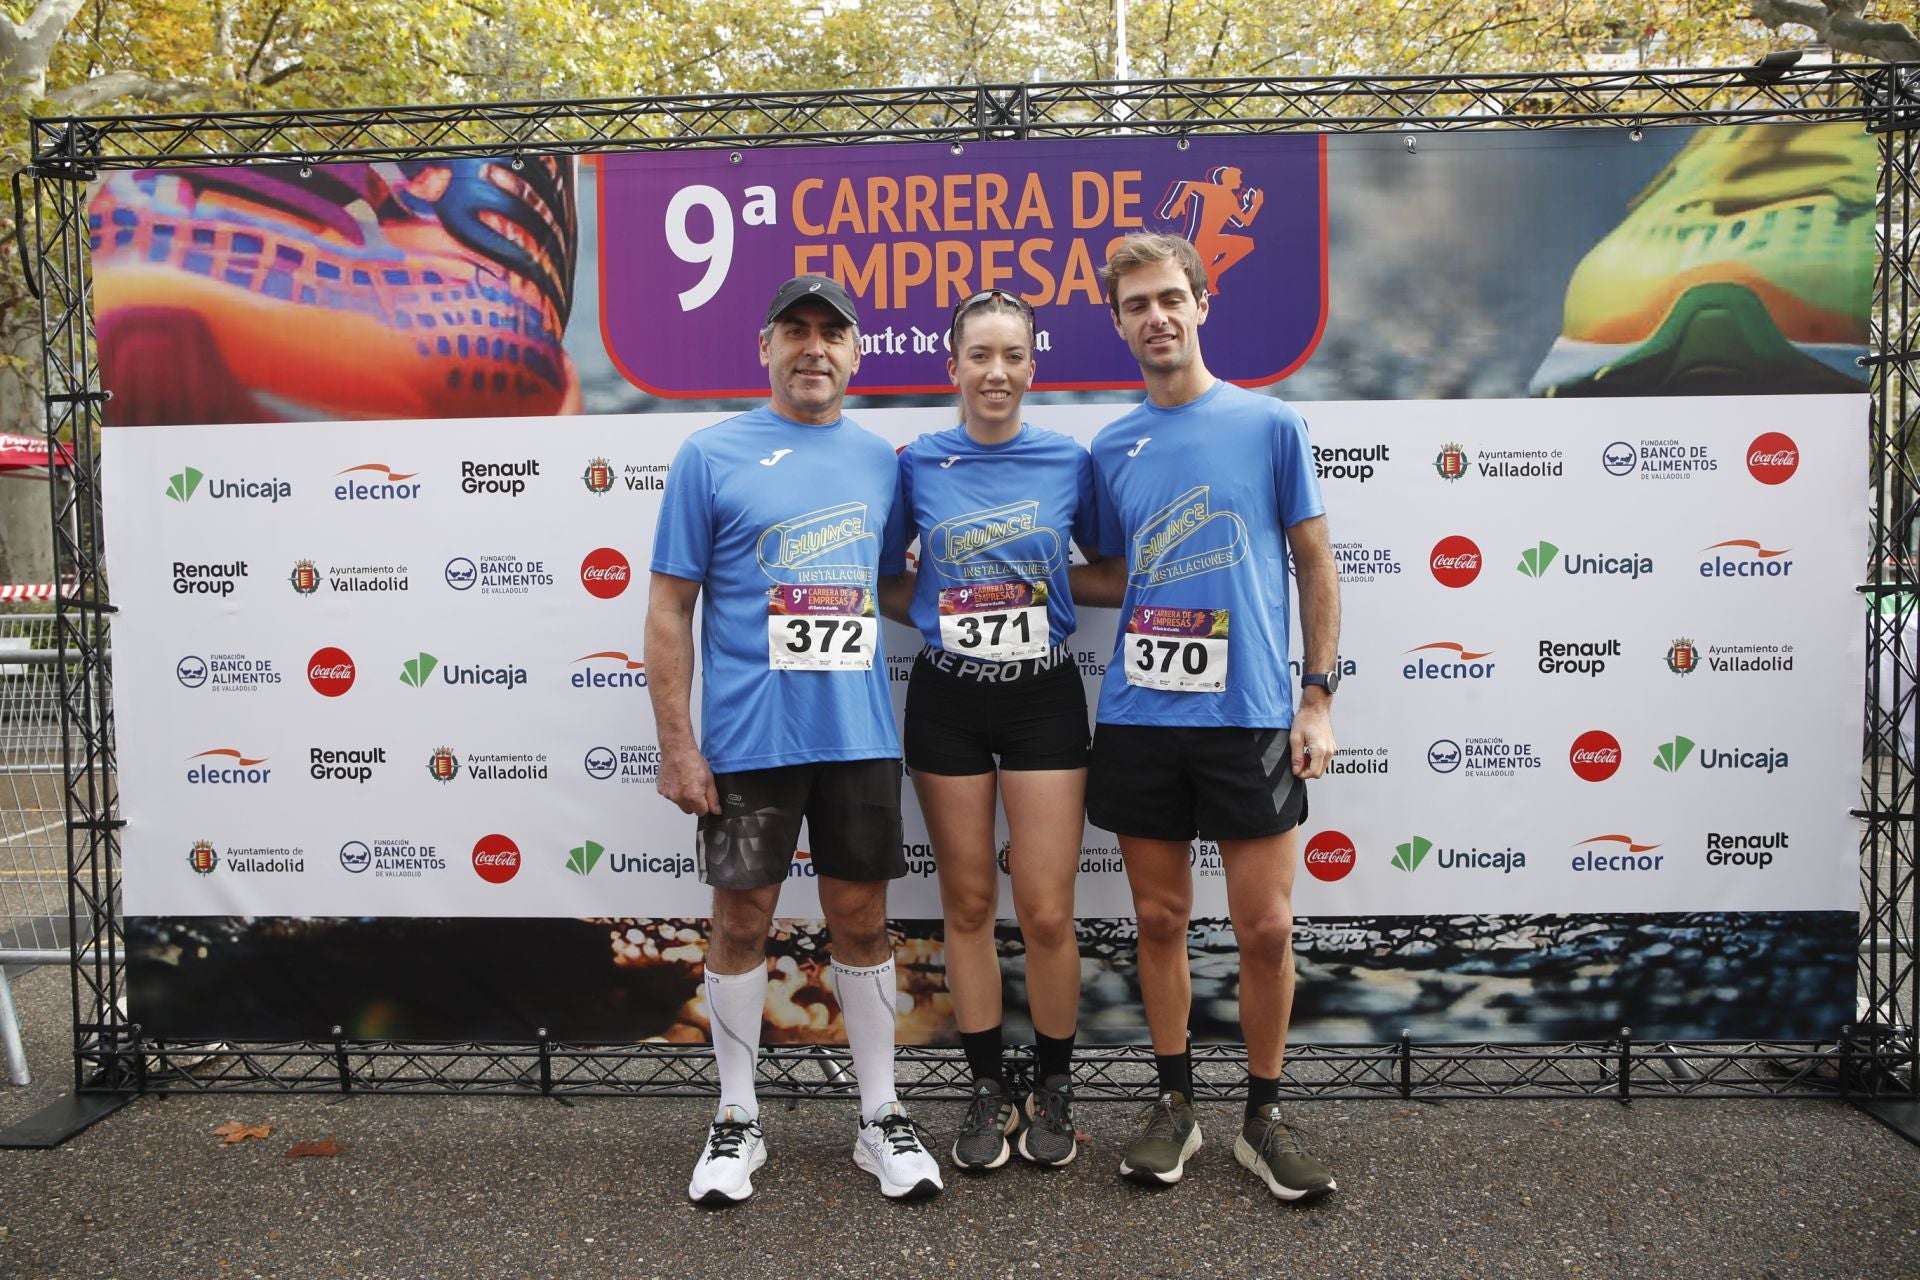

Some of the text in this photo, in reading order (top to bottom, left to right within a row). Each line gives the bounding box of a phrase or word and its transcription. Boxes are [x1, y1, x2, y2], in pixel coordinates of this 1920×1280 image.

[792, 170, 1143, 236] CARRERA DE
[861, 326, 908, 356] orte
[911, 326, 939, 354] de
[1478, 449, 1562, 462] Ayuntamiento de
[1641, 447, 1707, 458] BANCO DE
[462, 460, 539, 477] Renault
[625, 465, 669, 475] Ayuntami
[1479, 462, 1562, 477] Valladolid
[1641, 460, 1717, 471] ALIMENTOS
[210, 478, 291, 503] Unicaja
[335, 480, 420, 500] elecnor
[462, 478, 525, 497] Group
[625, 476, 664, 490] Valla
[785, 517, 862, 563] FLUINCE
[950, 514, 1031, 558] FLUINCE
[1334, 550, 1390, 561] ANCO DE
[173, 561, 248, 577] Renault
[330, 565, 407, 576] Ayuntamiento de
[481, 562, 543, 573] BANCO DE
[1151, 551, 1233, 583] INSTALACIONES
[1565, 553, 1652, 579] Unicaja
[1700, 556, 1792, 577] elecnor
[173, 578, 234, 597] Group
[330, 577, 408, 591] Valladolid
[482, 575, 553, 586] ALIMENTOS
[808, 588, 839, 597] CARRERA
[974, 585, 1004, 595] CARRERA
[1005, 583, 1015, 591] DE
[974, 591, 1015, 602] EMPRESAS
[808, 597, 849, 606] EMPRESAS
[1154, 609, 1181, 618] CARRERA
[1152, 616, 1192, 627] EMPRESAS
[786, 619, 863, 653] 372
[956, 611, 1030, 649] 371
[1540, 640, 1620, 656] Renault
[1709, 644, 1793, 656] Ayuntamiento de
[1136, 638, 1208, 675] 370
[1709, 656, 1792, 671] Valladolid
[211, 661, 271, 671] BANCO DE
[957, 661, 1022, 683] PRO
[1403, 659, 1495, 679] elecnor
[1539, 657, 1605, 677] Group
[213, 673, 281, 683] ALIMENTOS
[444, 664, 527, 690] Unicaja
[572, 667, 649, 689] elecno
[311, 748, 386, 763] Renault
[1377, 747, 1388, 755] de
[1466, 745, 1531, 755] BANCO DE
[468, 754, 533, 764] Ayuntamiento
[1466, 757, 1541, 768] ALIMENTOS
[1701, 748, 1788, 773] Unicaja
[188, 764, 270, 783] elecnor
[311, 764, 372, 783] Group
[469, 765, 547, 779] Valladolid
[1708, 832, 1788, 848] Renault
[227, 847, 303, 858] Ayuntamiento de
[375, 847, 435, 857] BANCO DE
[1707, 849, 1772, 869] Group
[228, 859, 303, 872] Valladolid
[376, 859, 445, 869] ALIMENTOS
[611, 853, 694, 878] Unicaja
[1439, 848, 1525, 873] Unicaja
[1572, 851, 1663, 871] elecnor
